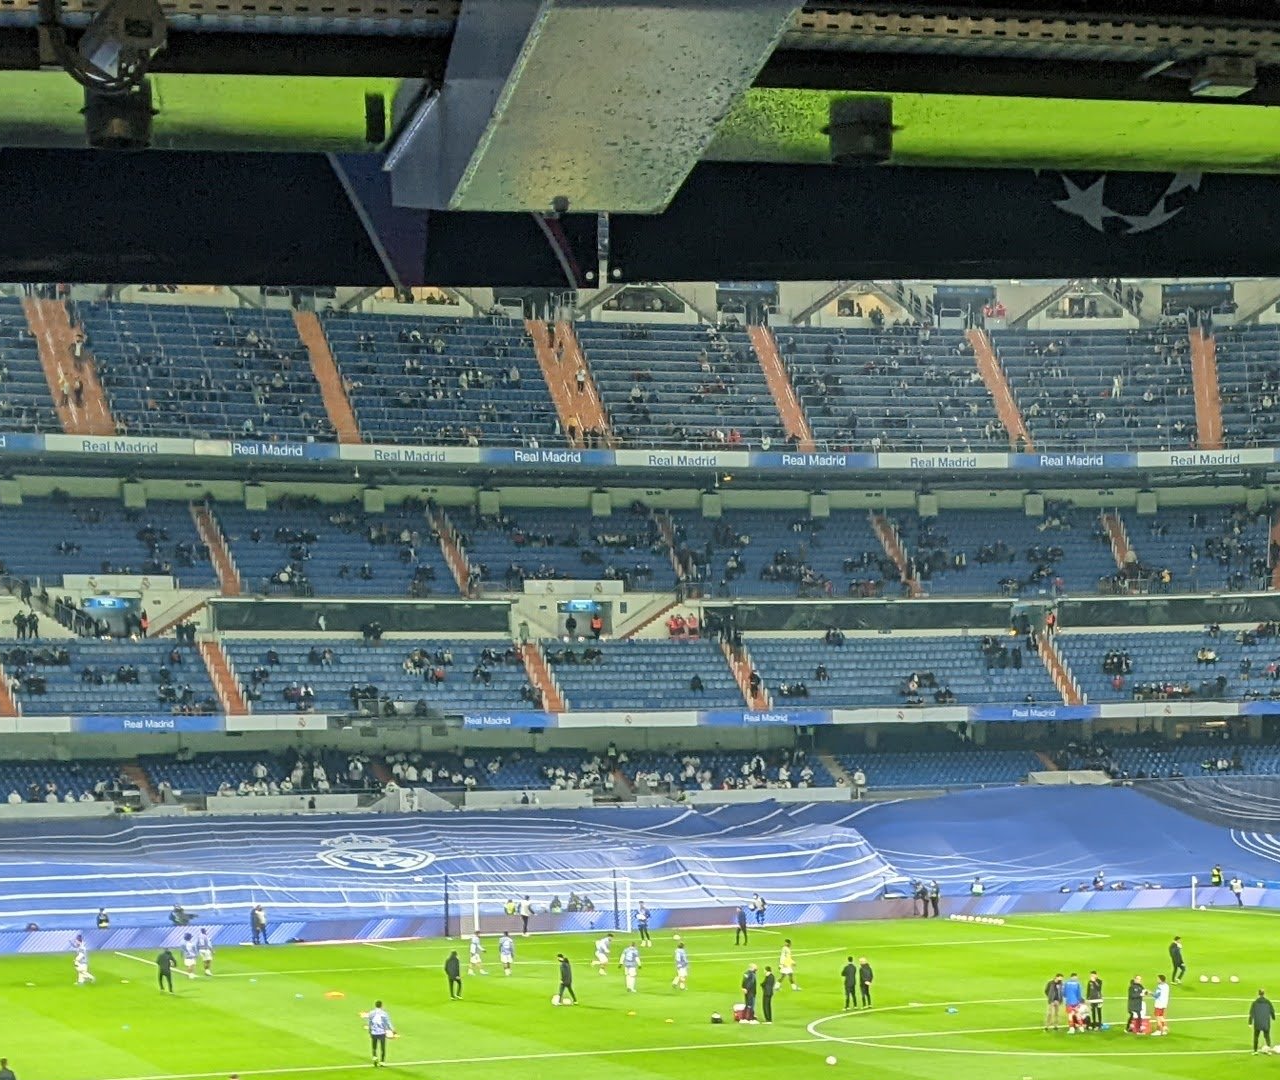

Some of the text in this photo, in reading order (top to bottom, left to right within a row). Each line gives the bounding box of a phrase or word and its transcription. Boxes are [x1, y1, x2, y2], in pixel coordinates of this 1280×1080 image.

[82, 440, 159, 455] Real Madrid
[233, 443, 304, 458] Real Madrid
[374, 449, 447, 463] Real Madrid
[514, 450, 582, 464] Real Madrid
[648, 455, 717, 468] Real Madrid
[782, 454, 847, 468] Real Madrid
[910, 456, 977, 469] Real Madrid
[1040, 454, 1104, 468] Real Madrid
[1170, 453, 1240, 467] Real Madrid
